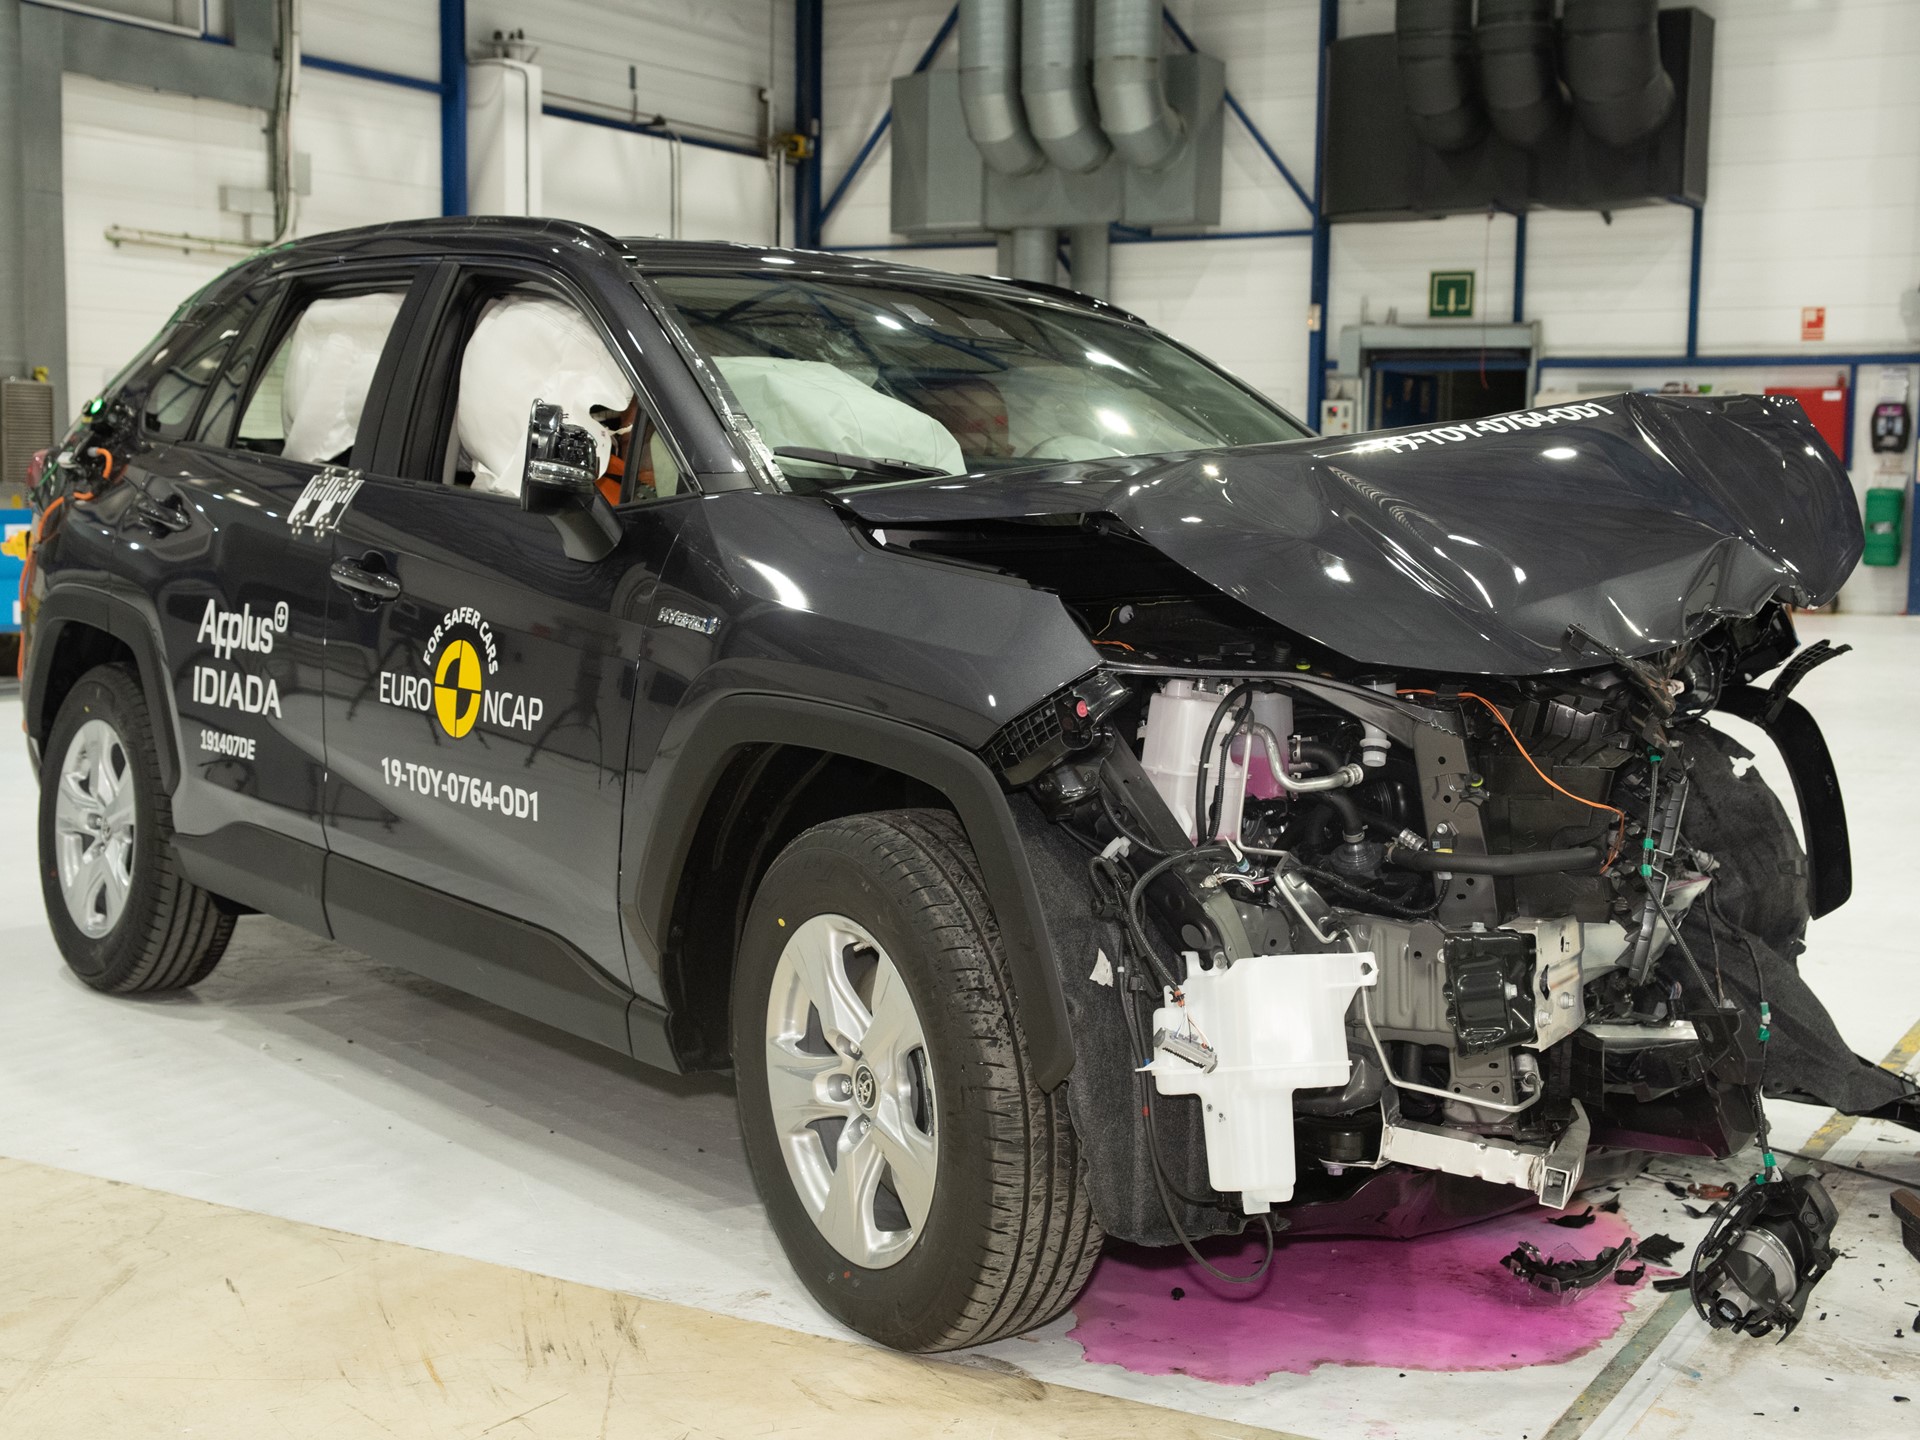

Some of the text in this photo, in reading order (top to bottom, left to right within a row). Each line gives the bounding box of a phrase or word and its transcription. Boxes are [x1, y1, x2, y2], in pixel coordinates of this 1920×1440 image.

[196, 598, 275, 660] Applus
[423, 606, 499, 675] FOR SAFER CARS
[192, 665, 283, 719] IDIADA
[379, 671, 544, 731] EURO NCAP
[200, 729, 256, 761] 191407DE
